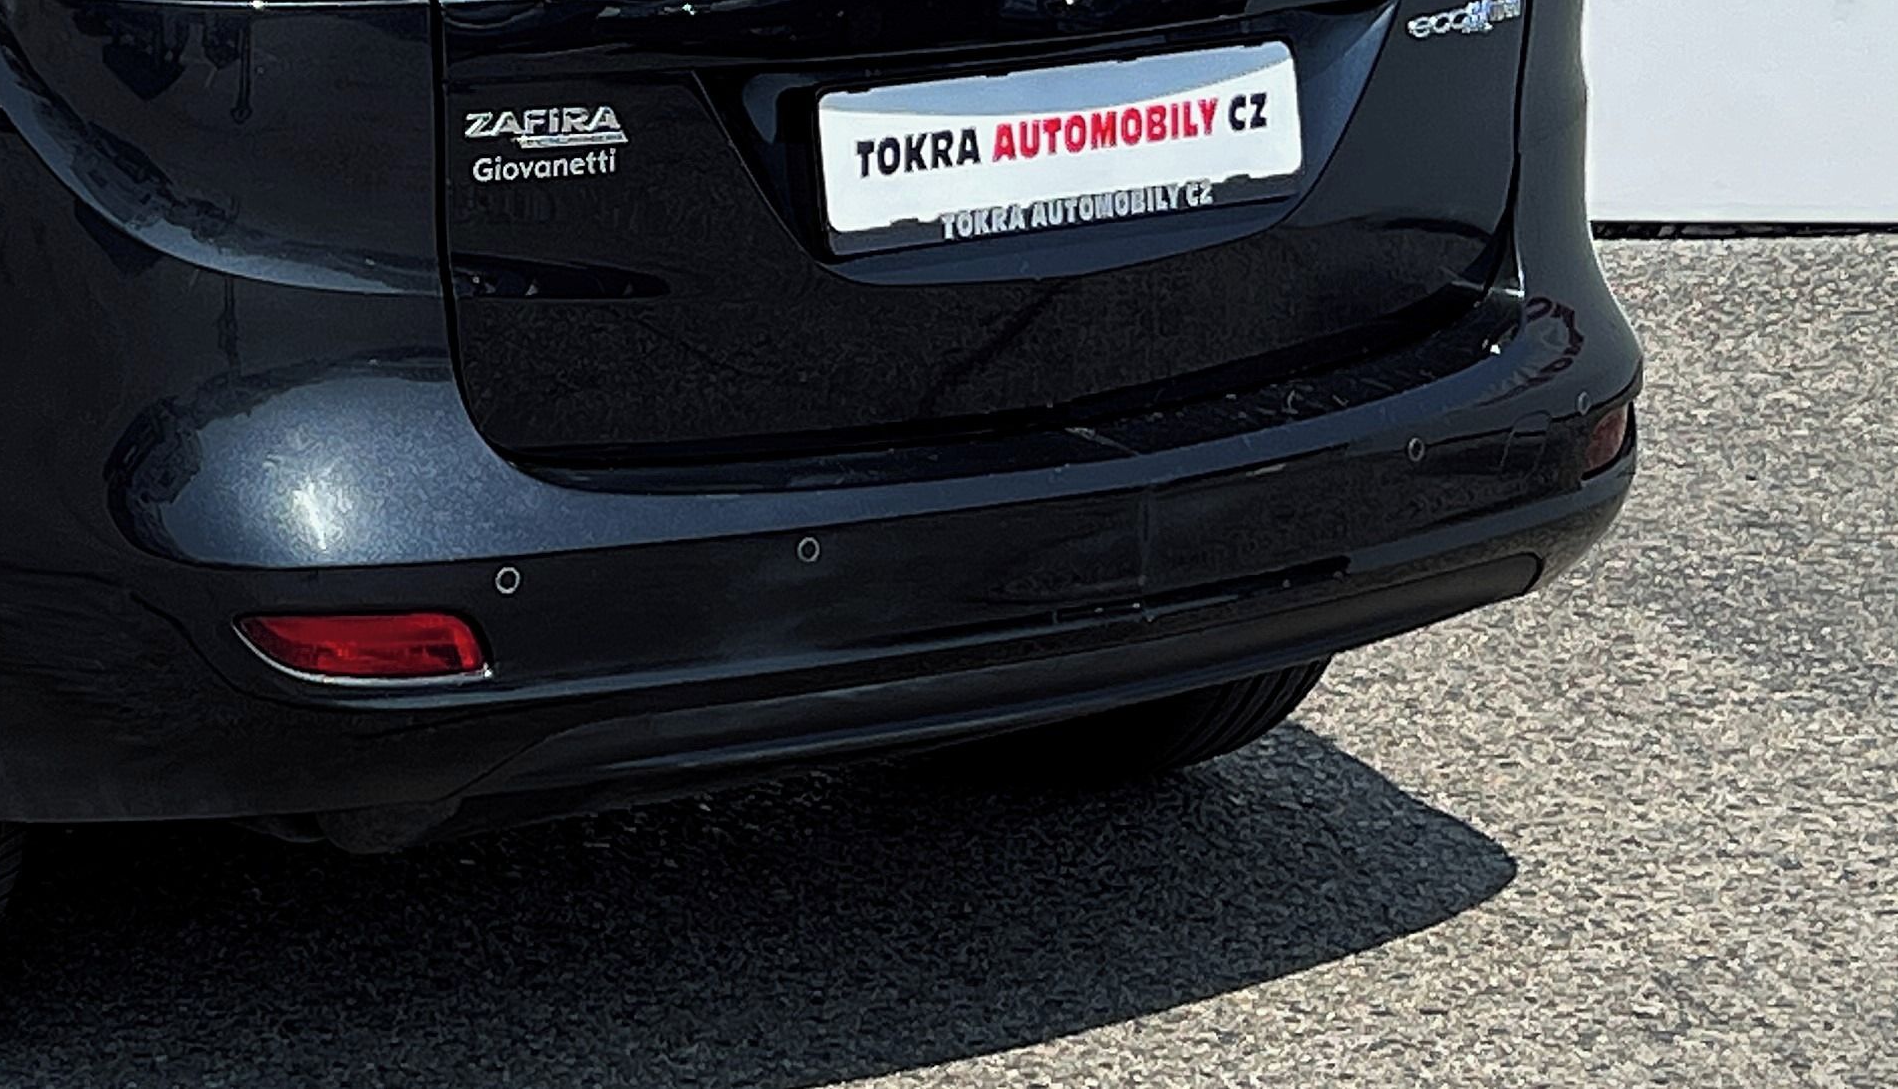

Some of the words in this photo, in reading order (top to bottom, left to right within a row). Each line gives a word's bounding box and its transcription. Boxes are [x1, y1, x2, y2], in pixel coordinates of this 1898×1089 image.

[465, 106, 621, 138] ZAFIRA
[856, 125, 981, 178] TOKRA
[992, 97, 1219, 162] AUTOMOBILY
[1228, 92, 1268, 131] CZ
[472, 148, 617, 182] Giovanetti
[940, 203, 1026, 240] TOKRA
[1030, 183, 1181, 228] AUTOMOBILY
[1185, 178, 1214, 207] CZ
